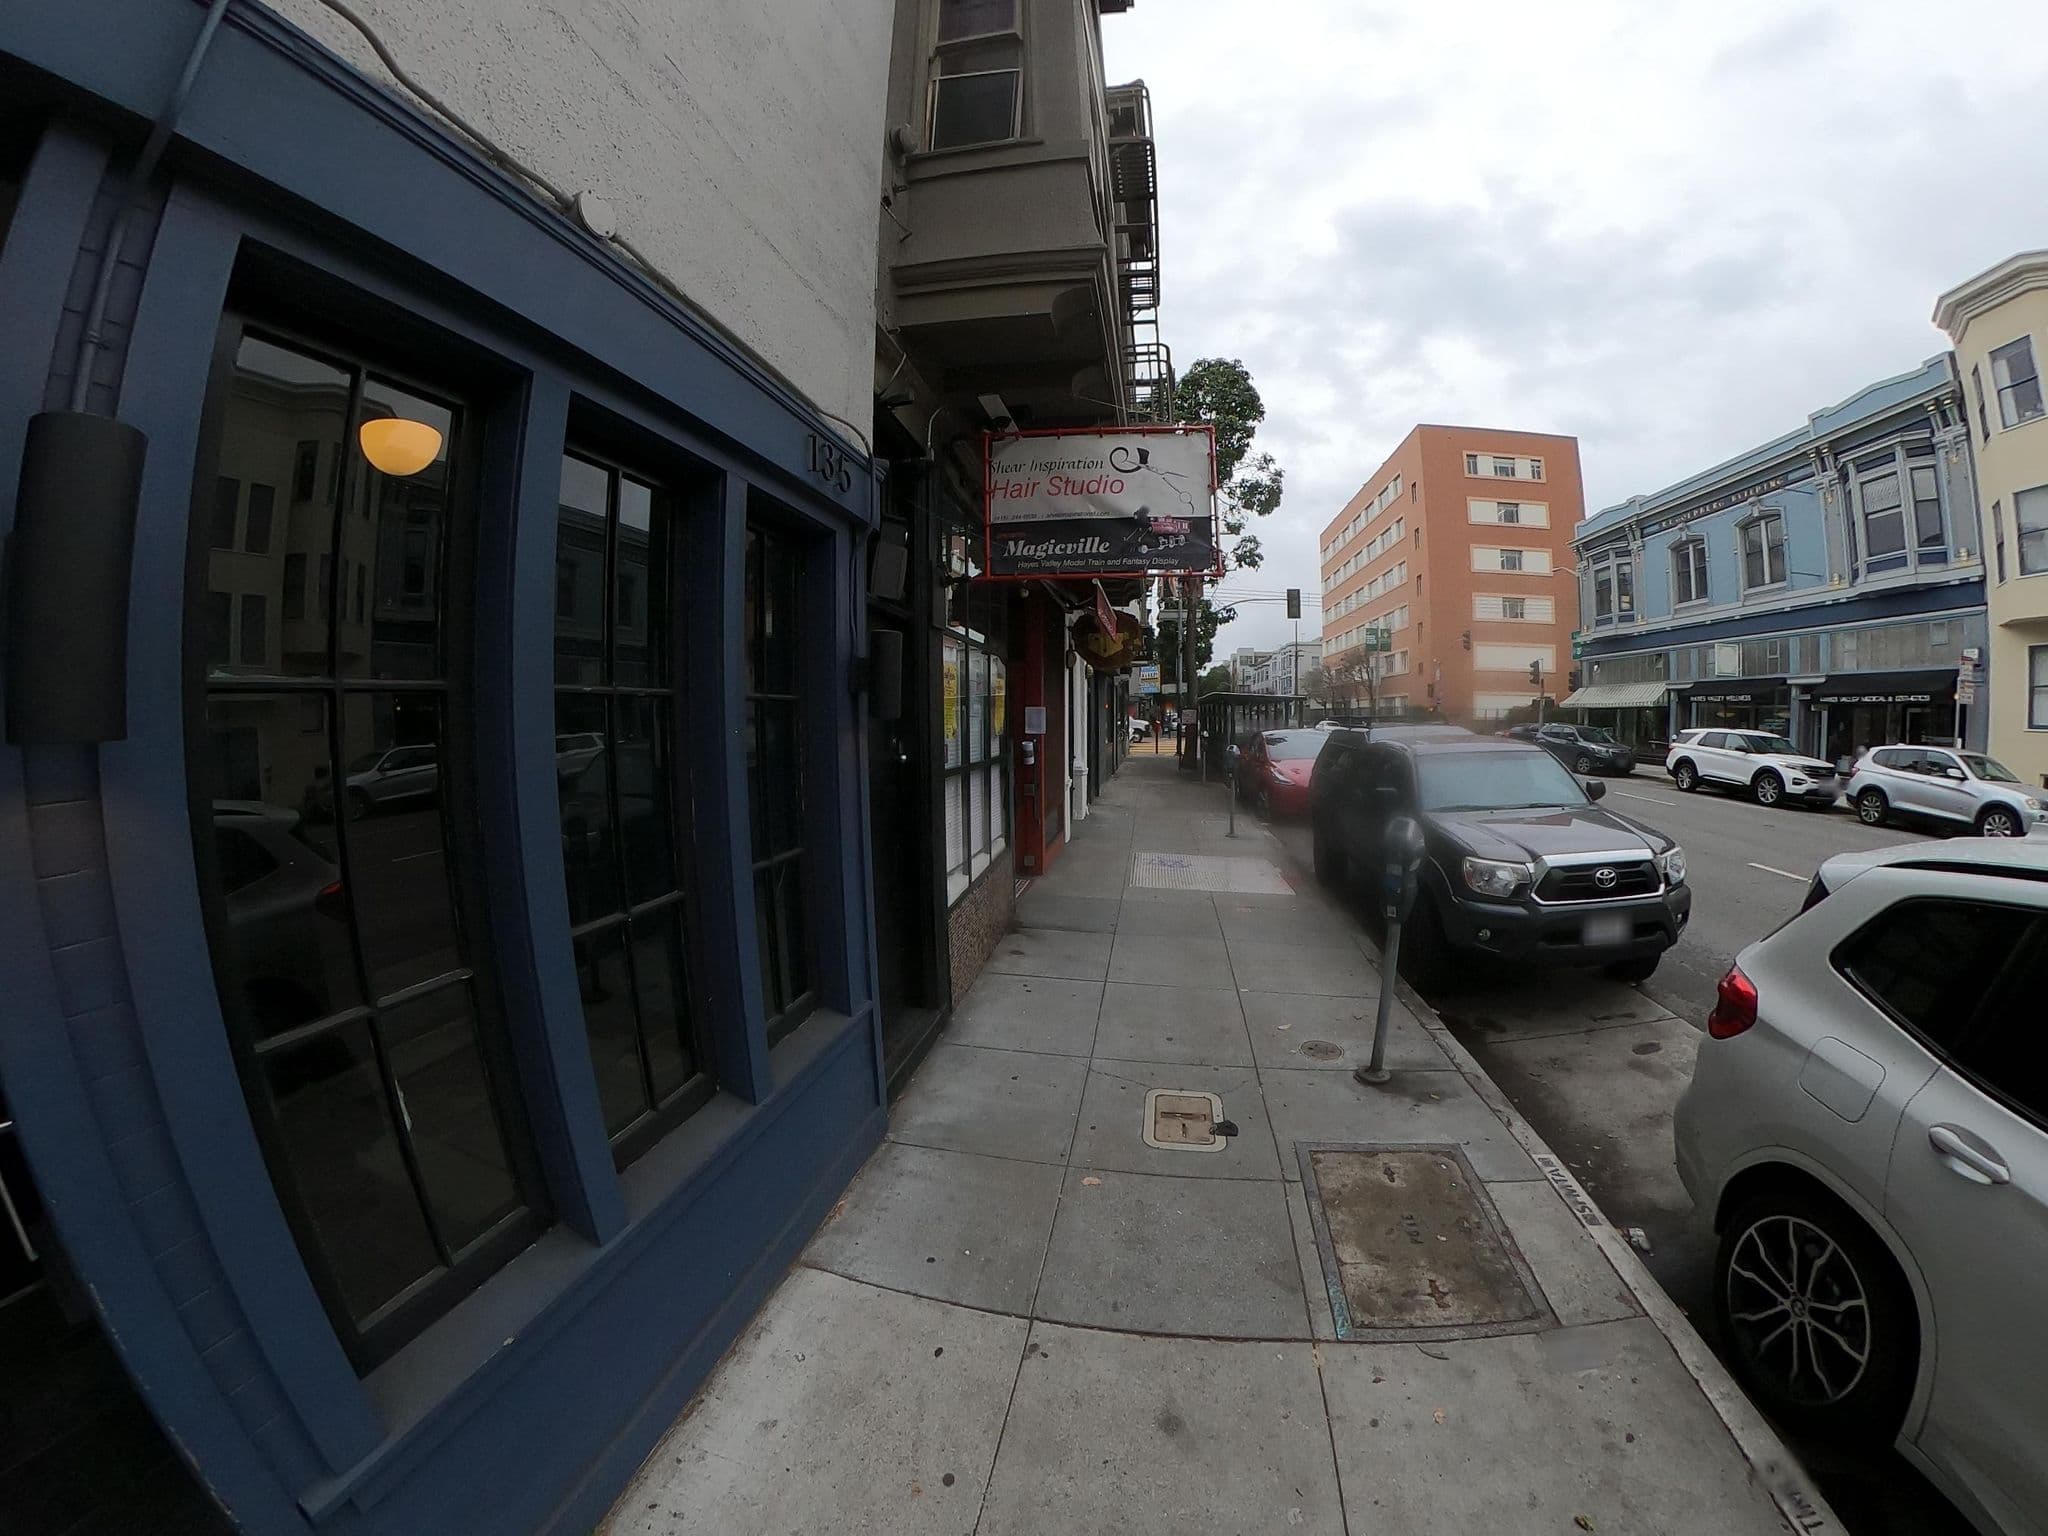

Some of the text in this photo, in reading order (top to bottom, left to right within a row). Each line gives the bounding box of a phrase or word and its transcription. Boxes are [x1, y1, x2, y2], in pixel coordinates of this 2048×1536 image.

[807, 432, 852, 494] 135
[991, 456, 1104, 477] Shear Inspiration
[991, 474, 1125, 500] Hair Studio
[1003, 536, 1111, 559] Magicville
[1017, 556, 1179, 569] Hayes Valley Model Train and Fantasy Display
